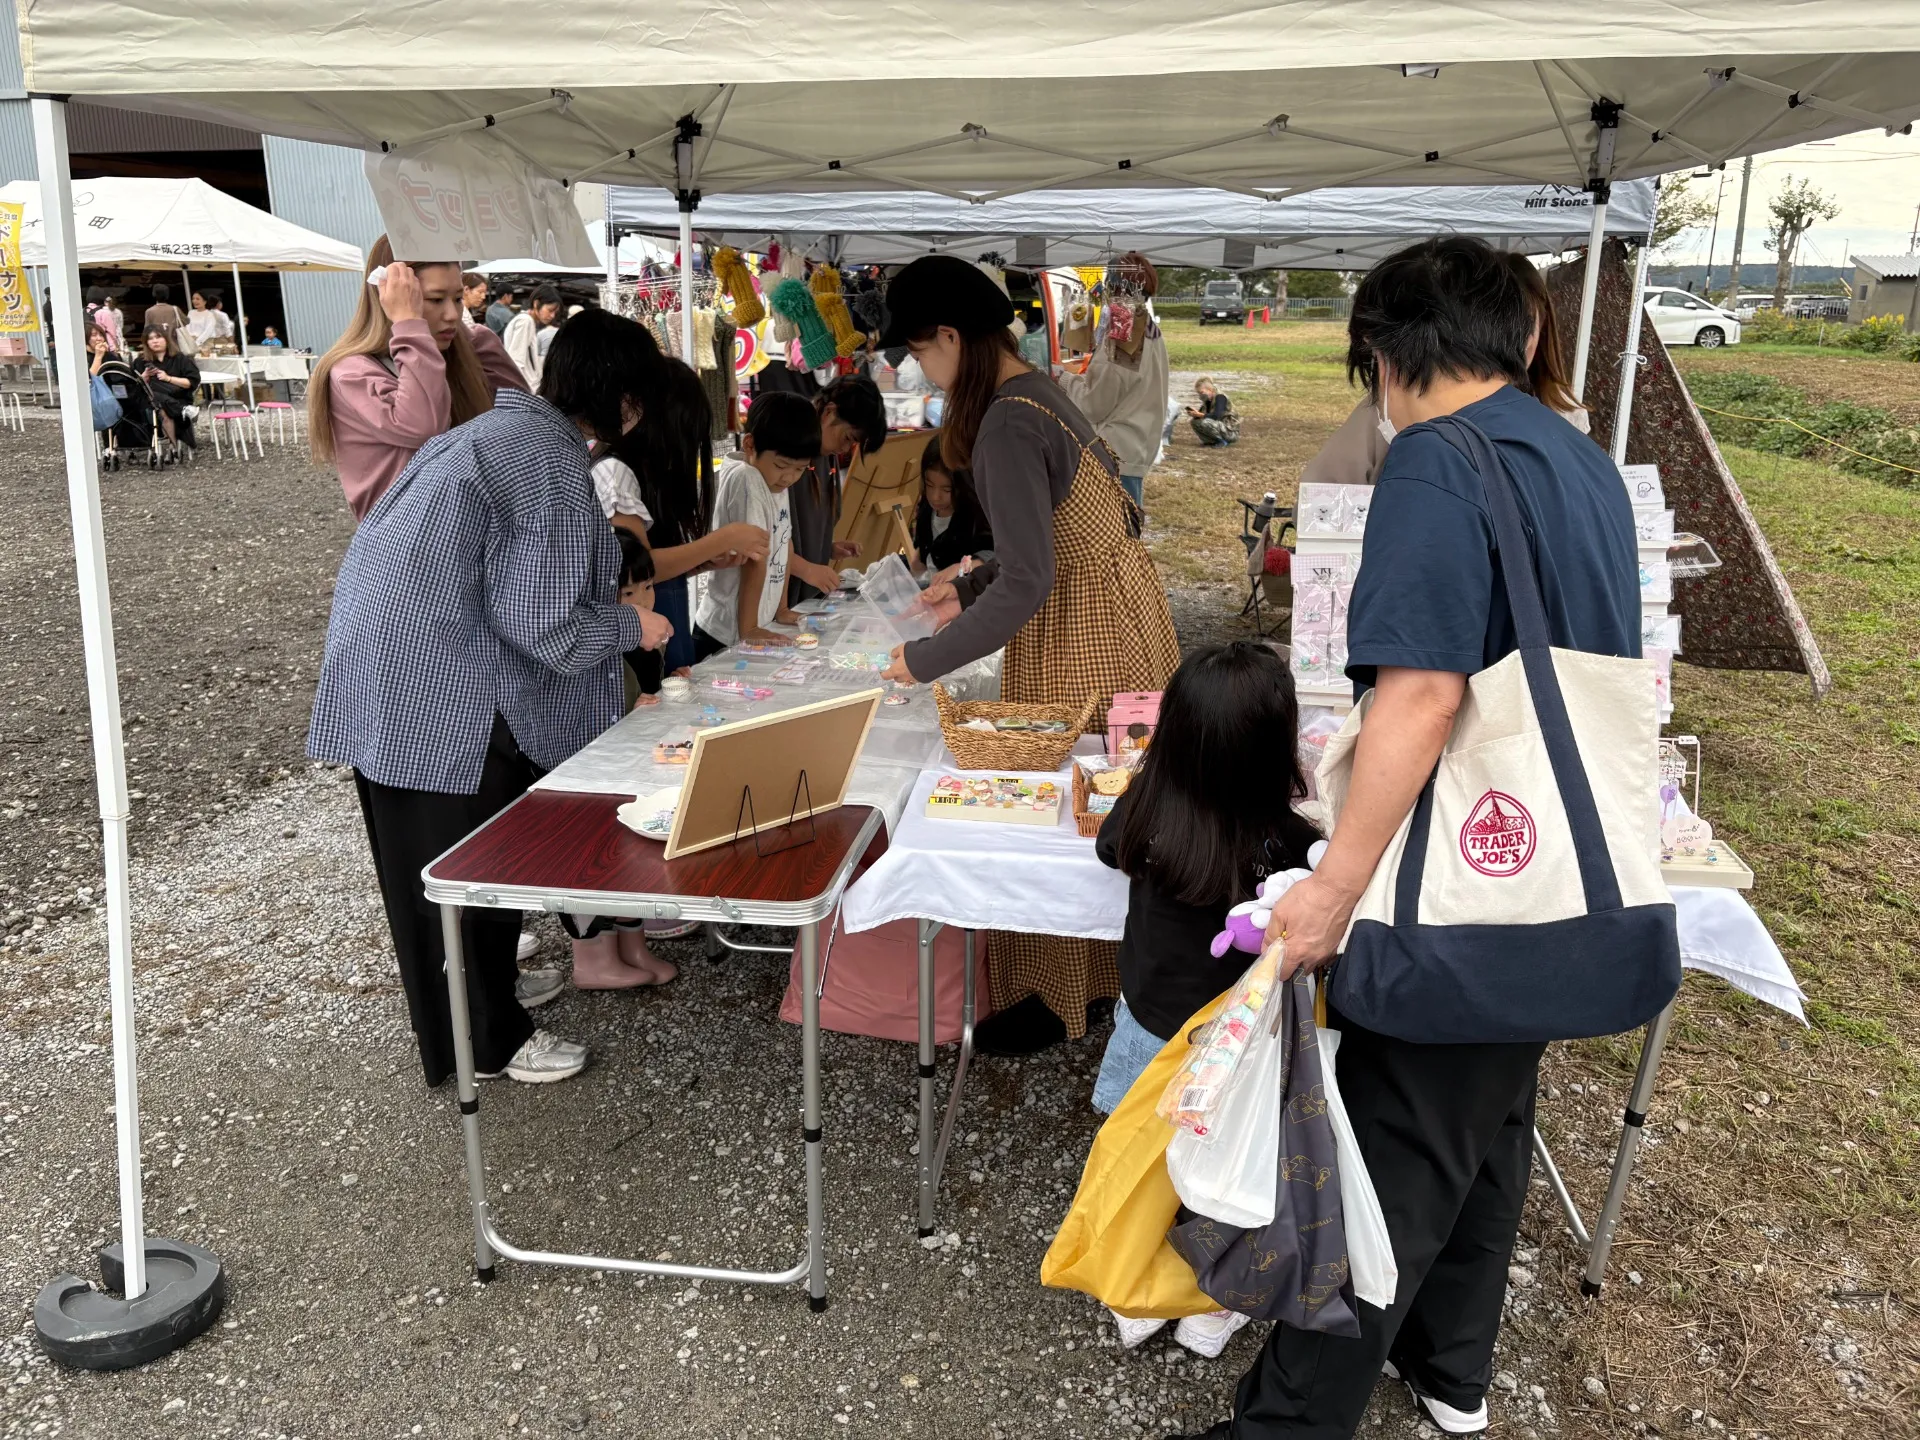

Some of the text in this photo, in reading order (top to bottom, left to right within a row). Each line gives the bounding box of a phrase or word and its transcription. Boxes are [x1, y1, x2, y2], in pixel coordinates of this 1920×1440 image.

[1524, 197, 1589, 208] Hill Stone
[150, 243, 213, 255] 平成23年度
[1469, 831, 1527, 850] TRADER
[1476, 848, 1520, 864] JOE'S
